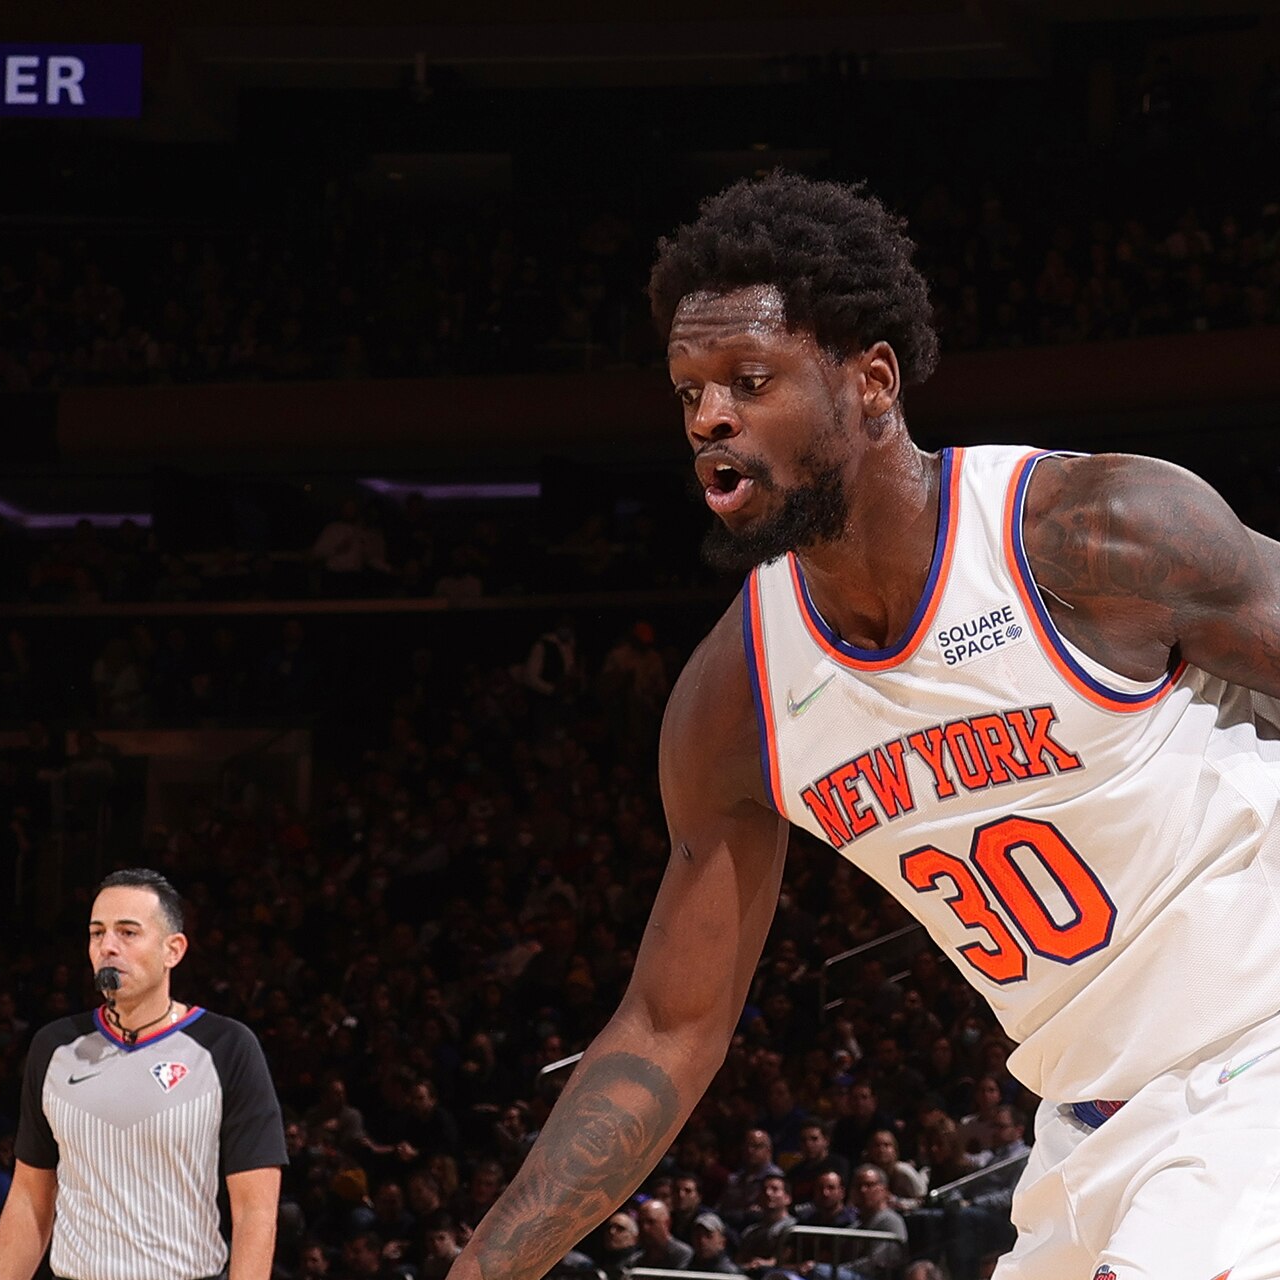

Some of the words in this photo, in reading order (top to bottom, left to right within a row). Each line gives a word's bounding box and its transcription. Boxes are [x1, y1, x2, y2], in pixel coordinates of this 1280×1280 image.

[937, 604, 1016, 649] SQUARE
[943, 632, 1007, 667] SPACE
[799, 737, 917, 851] NEW
[910, 705, 1083, 800] YORK
[899, 814, 1118, 985] 30
